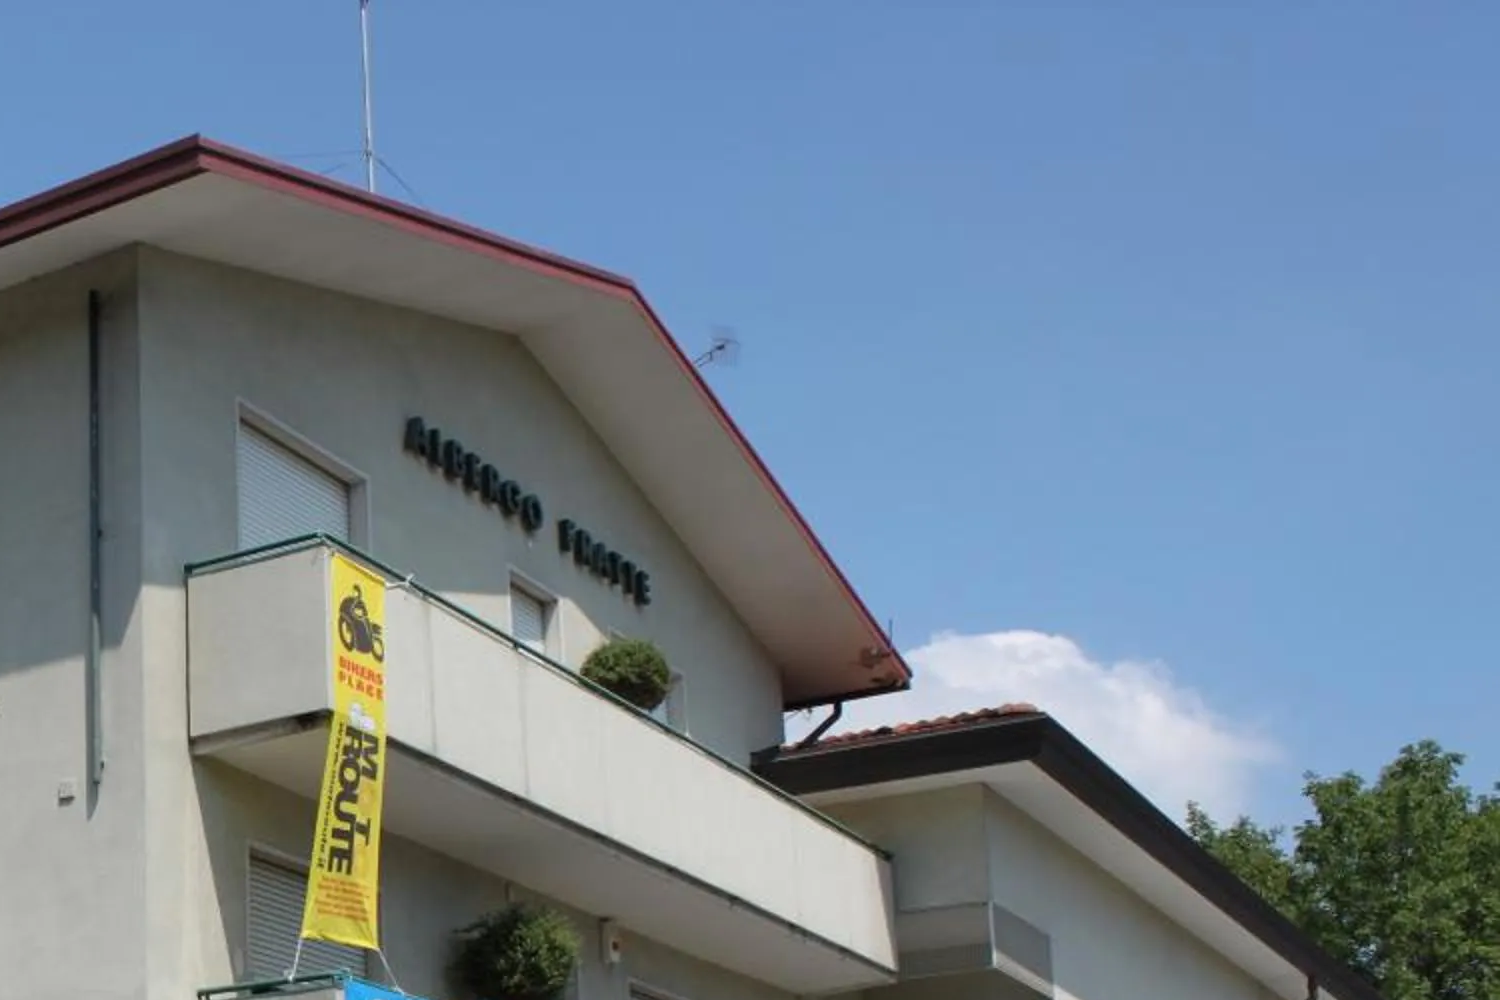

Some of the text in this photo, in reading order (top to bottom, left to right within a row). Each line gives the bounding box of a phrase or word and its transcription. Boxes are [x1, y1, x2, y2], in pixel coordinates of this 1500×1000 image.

[403, 416, 651, 606] ALBERGO FRATTE
[327, 726, 362, 875] ROUTE
